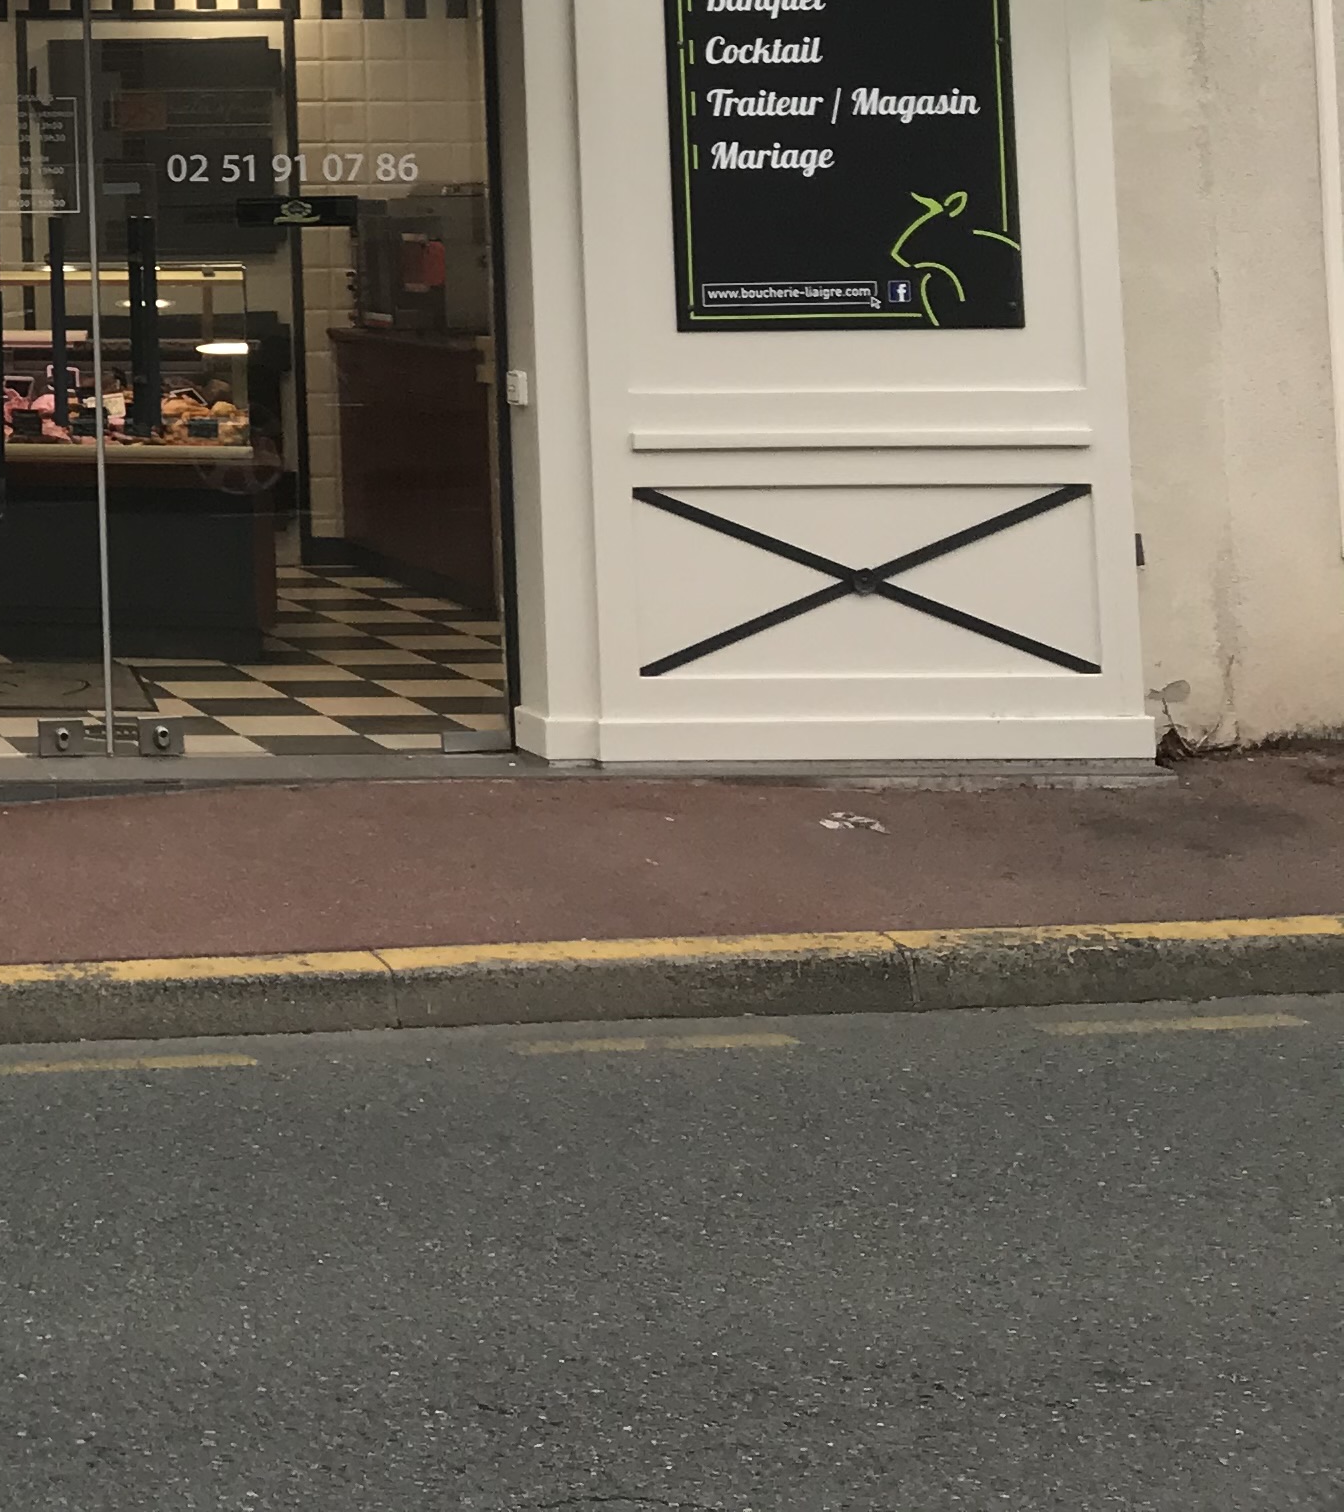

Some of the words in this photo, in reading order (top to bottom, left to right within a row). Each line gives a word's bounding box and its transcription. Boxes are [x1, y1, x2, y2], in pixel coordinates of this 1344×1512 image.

[705, 35, 823, 65] Cocktail
[706, 89, 824, 118] Traiteur
[830, 87, 842, 125] /
[851, 87, 981, 124] Magasin
[166, 154, 210, 182] 02
[221, 154, 256, 182] 51
[271, 154, 309, 182] 91
[322, 153, 364, 182] 07
[375, 153, 419, 182] 86
[710, 141, 835, 178] Mariage
[707, 286, 872, 300] www.boucherie-liaigre.com
